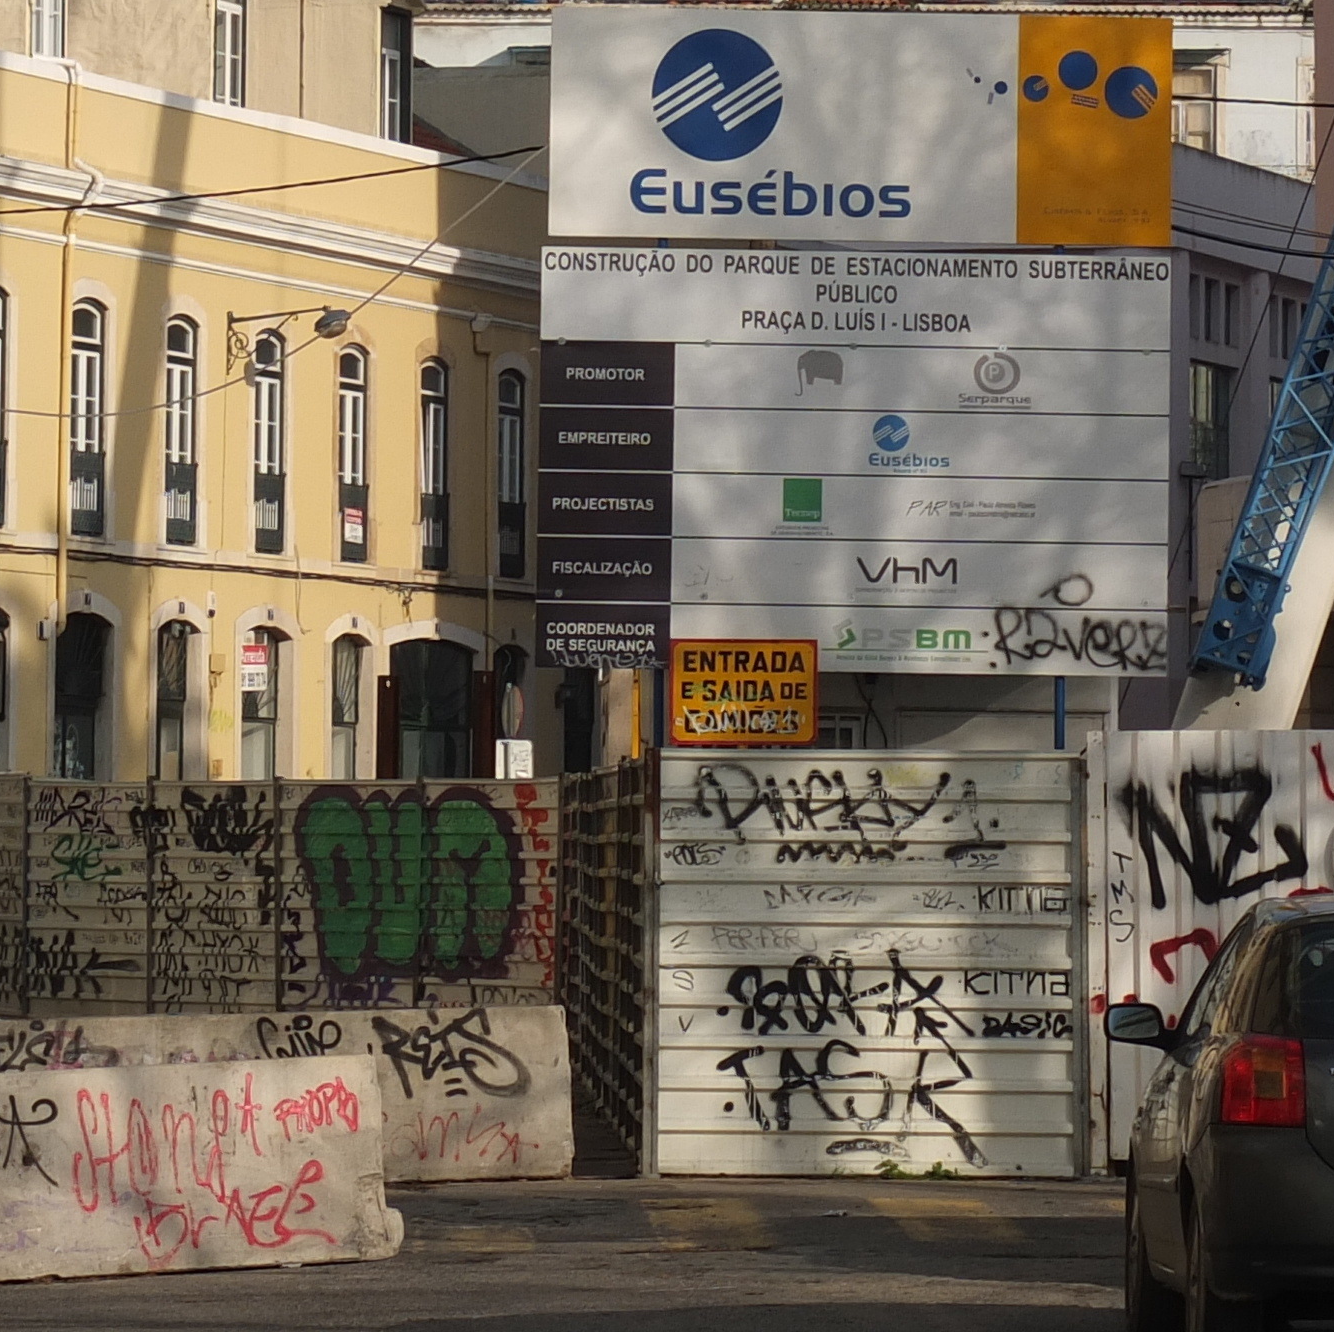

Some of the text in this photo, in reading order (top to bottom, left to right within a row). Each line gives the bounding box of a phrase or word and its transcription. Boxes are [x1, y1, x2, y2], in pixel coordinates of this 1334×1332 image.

[629, 168, 912, 218] Eusébios
[544, 251, 1169, 282] CONSTRUÇÃO DO PARQUE DE ESTACIONAMENTO SUBTERRÂNEO
[816, 279, 898, 304] PÚBLICO
[741, 309, 808, 334] PRAÇA
[812, 311, 831, 331] D.
[834, 307, 877, 332] LUÍS
[880, 312, 886, 332] I
[902, 313, 971, 333] LISBOA
[565, 366, 645, 382] PROMOTOR
[958, 393, 1032, 406] Serparque
[558, 431, 651, 446] EMPREITEIRO
[869, 453, 950, 468] Eusébios
[552, 497, 654, 513] PROJECTISTAS
[552, 560, 653, 578] FISCALIZAÇÃO
[546, 621, 655, 636] COORDENADOR
[546, 638, 655, 654] DE SEGURANÇA
[682, 650, 806, 674] ENTRADA
[681, 682, 694, 700] E
[780, 682, 808, 700] DE
